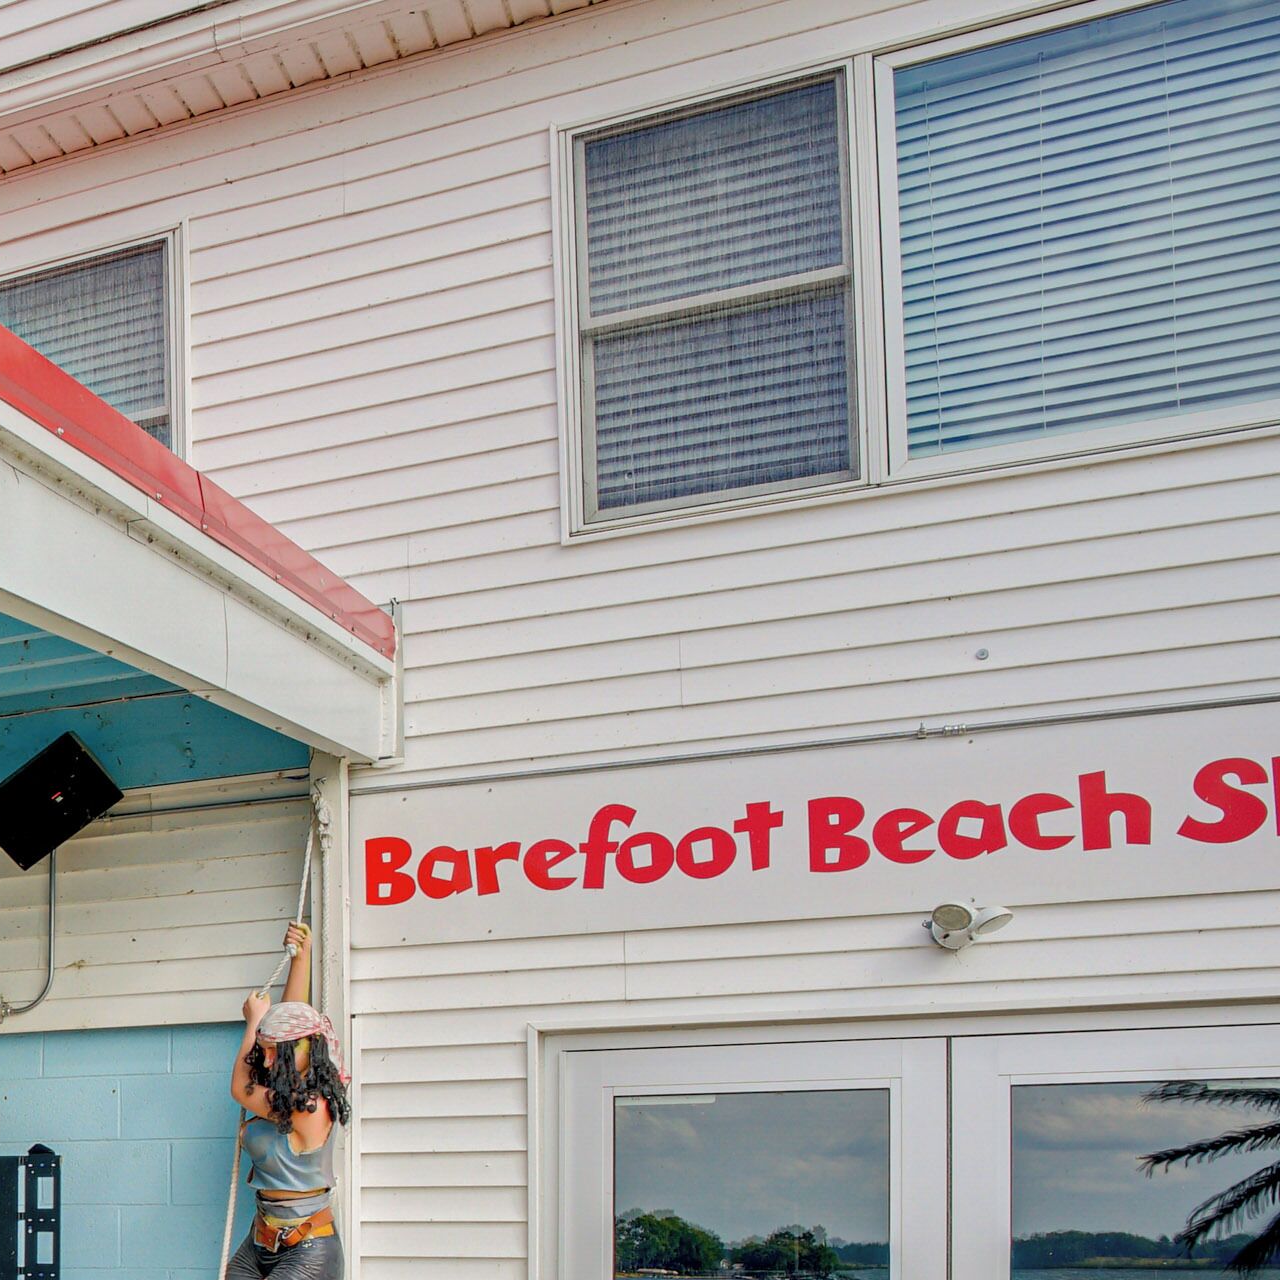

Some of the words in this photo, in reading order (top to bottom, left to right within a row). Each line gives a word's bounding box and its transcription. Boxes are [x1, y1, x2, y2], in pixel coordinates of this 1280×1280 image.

[365, 801, 784, 906] Barefoot
[808, 770, 1152, 873] Beach
[1176, 757, 1280, 844] S
